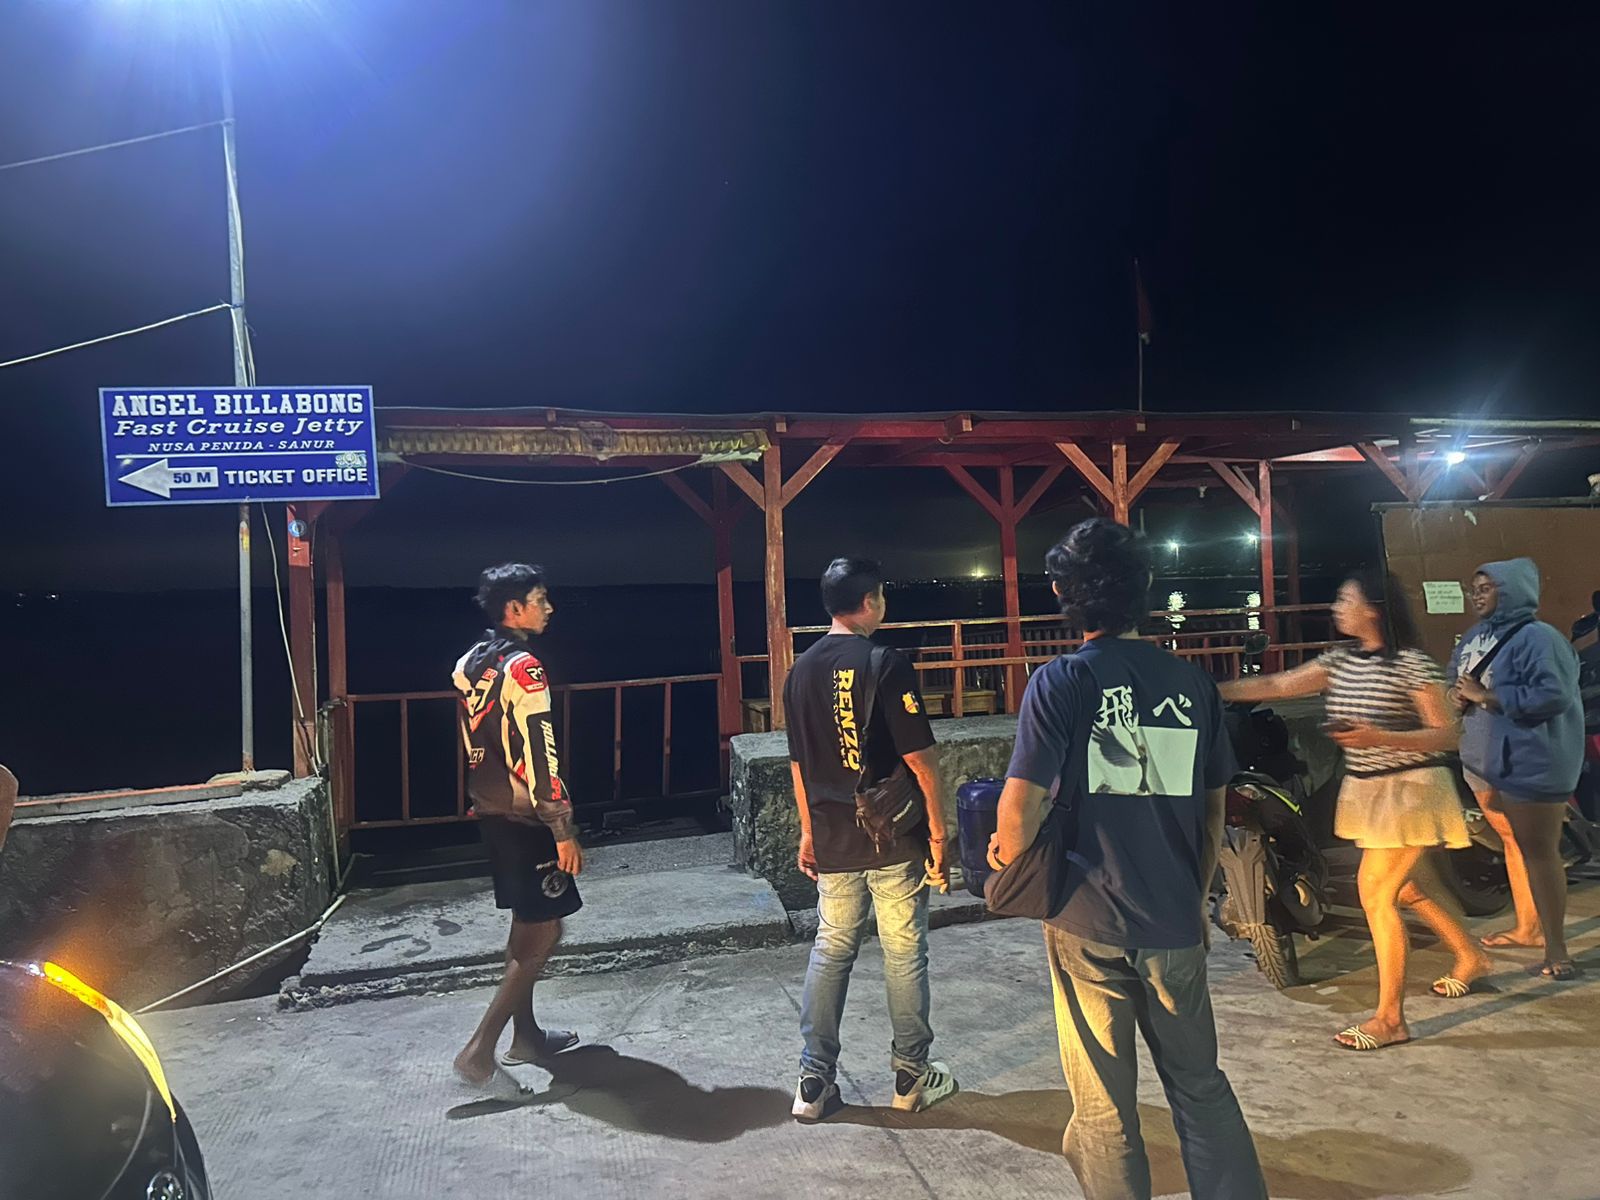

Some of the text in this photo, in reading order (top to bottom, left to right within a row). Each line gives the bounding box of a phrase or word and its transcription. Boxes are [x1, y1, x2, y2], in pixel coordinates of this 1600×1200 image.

[112, 394, 364, 416] ANGEL BILLABONG
[114, 417, 364, 436] Fast Cruise Jetty
[148, 442, 195, 452] NUSA
[200, 441, 264, 451] PENIDA
[278, 440, 335, 450] SANUR
[173, 472, 211, 484] 50 M
[224, 468, 368, 485] TICKET OFFICE
